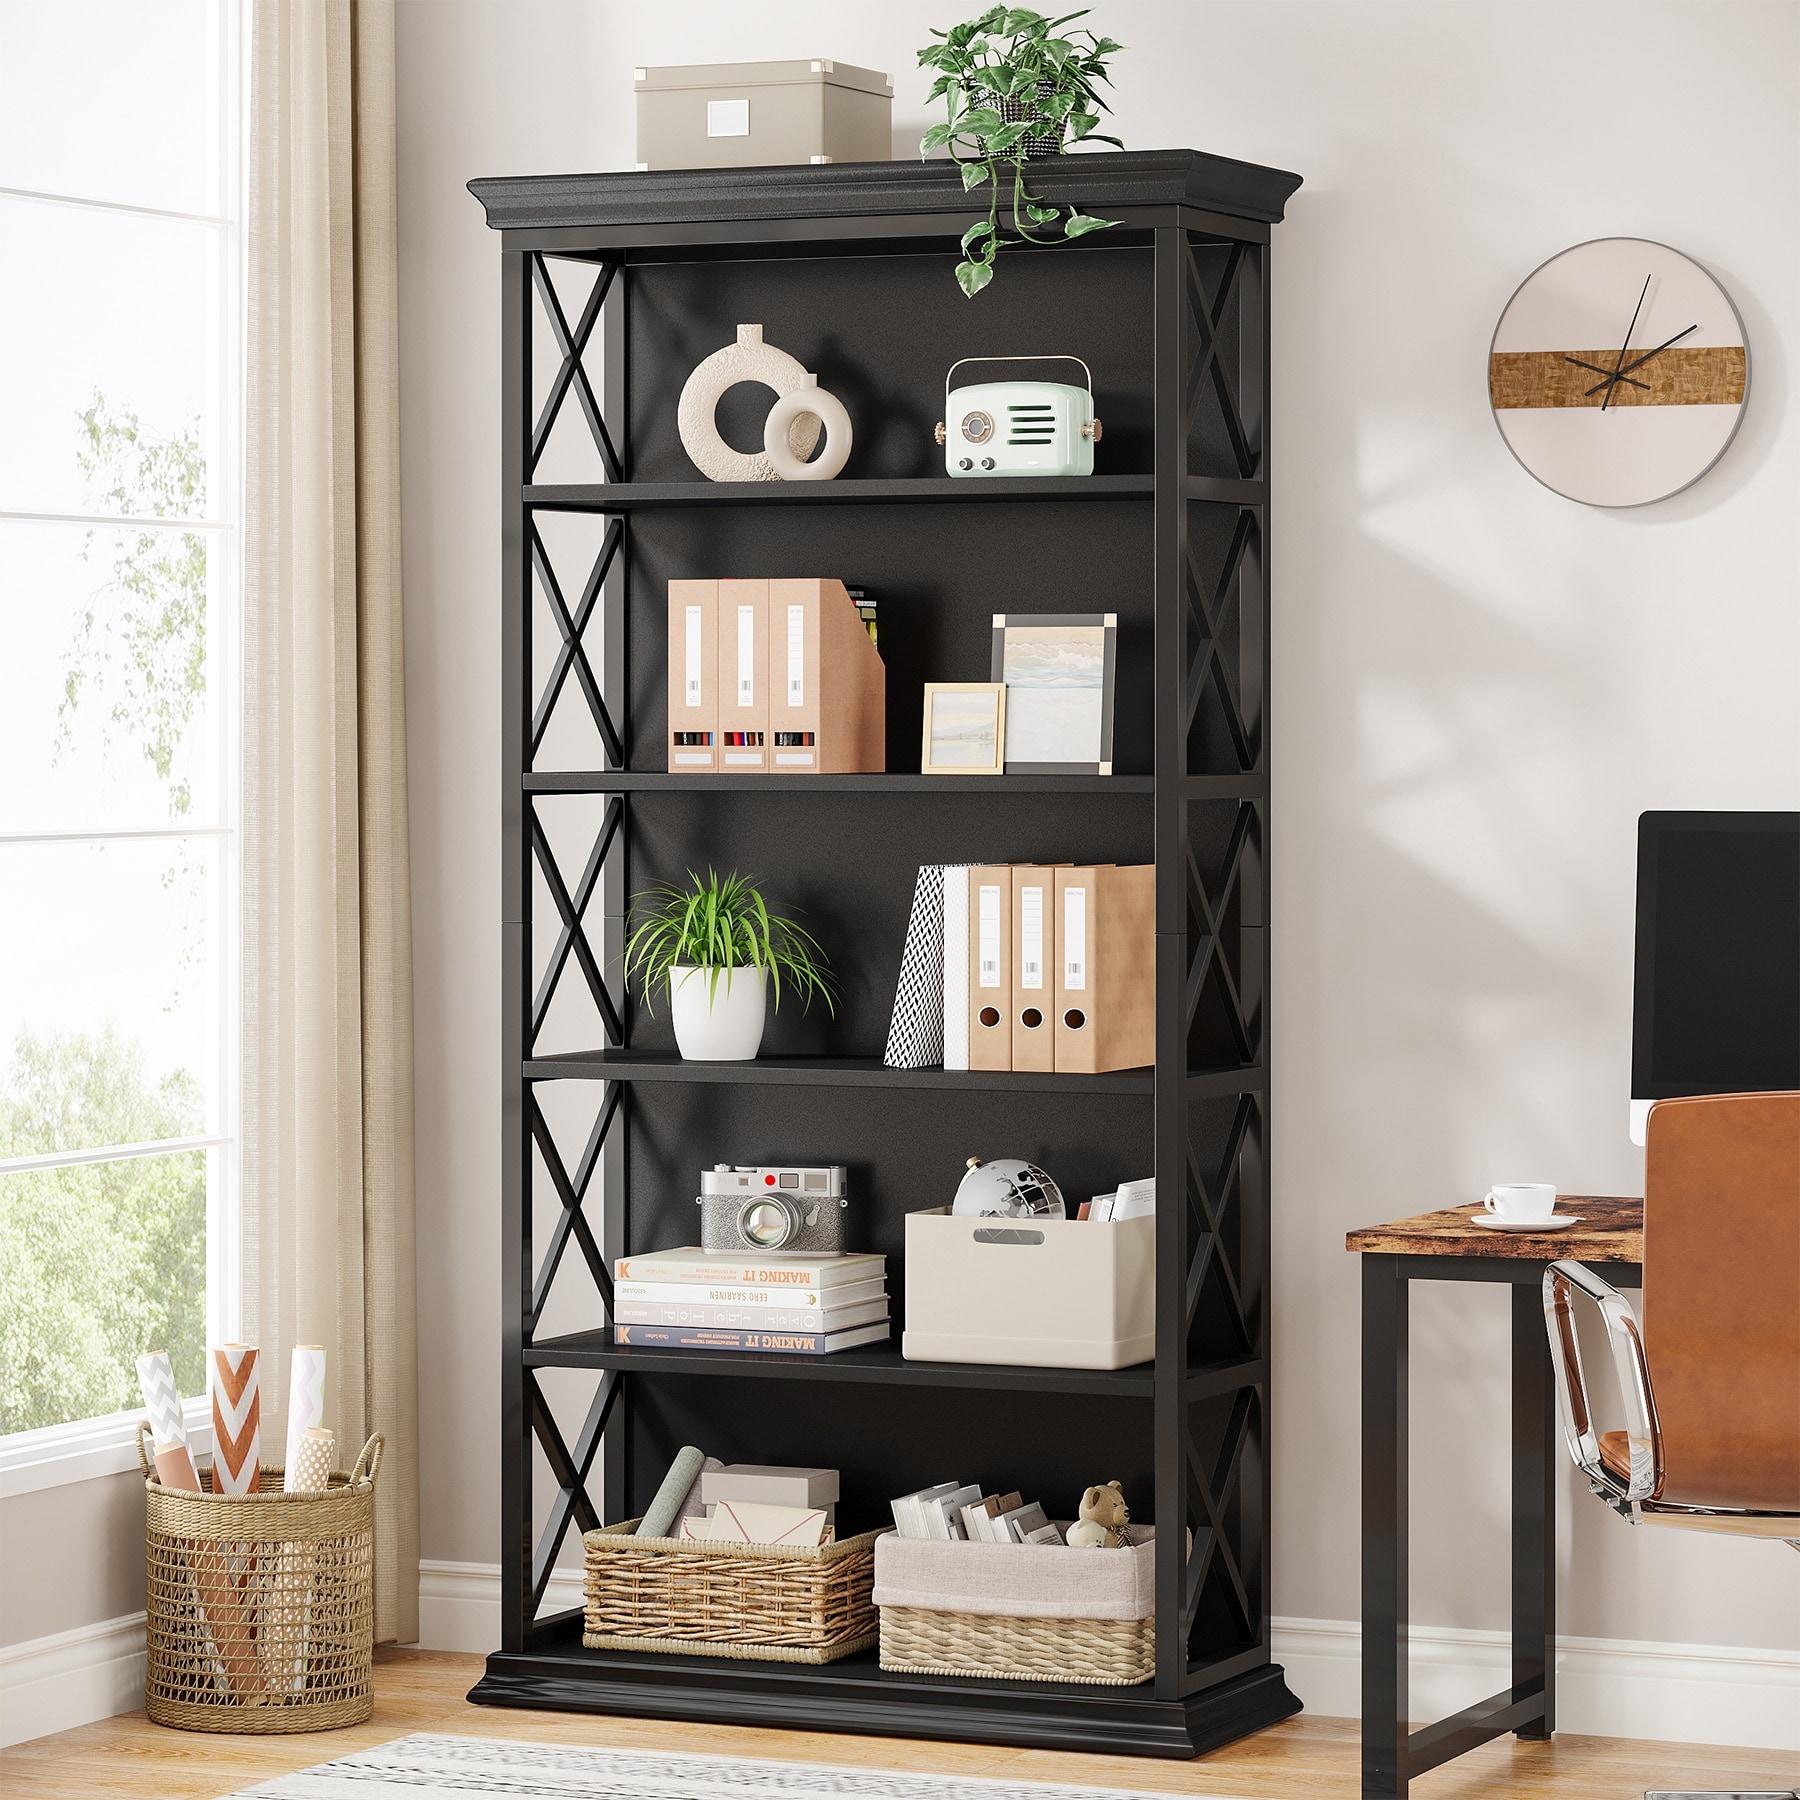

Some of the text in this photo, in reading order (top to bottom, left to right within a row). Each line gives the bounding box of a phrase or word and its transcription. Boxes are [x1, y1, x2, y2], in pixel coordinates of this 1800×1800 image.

[619, 1262, 630, 1278] K
[743, 1270, 811, 1284] MAKING IT
[710, 1290, 768, 1302] EERO SAARINEN
[717, 1311, 753, 1323] the
[767, 1314, 816, 1328] Over
[617, 1326, 631, 1344] K
[745, 1335, 816, 1350] MAKING IT
